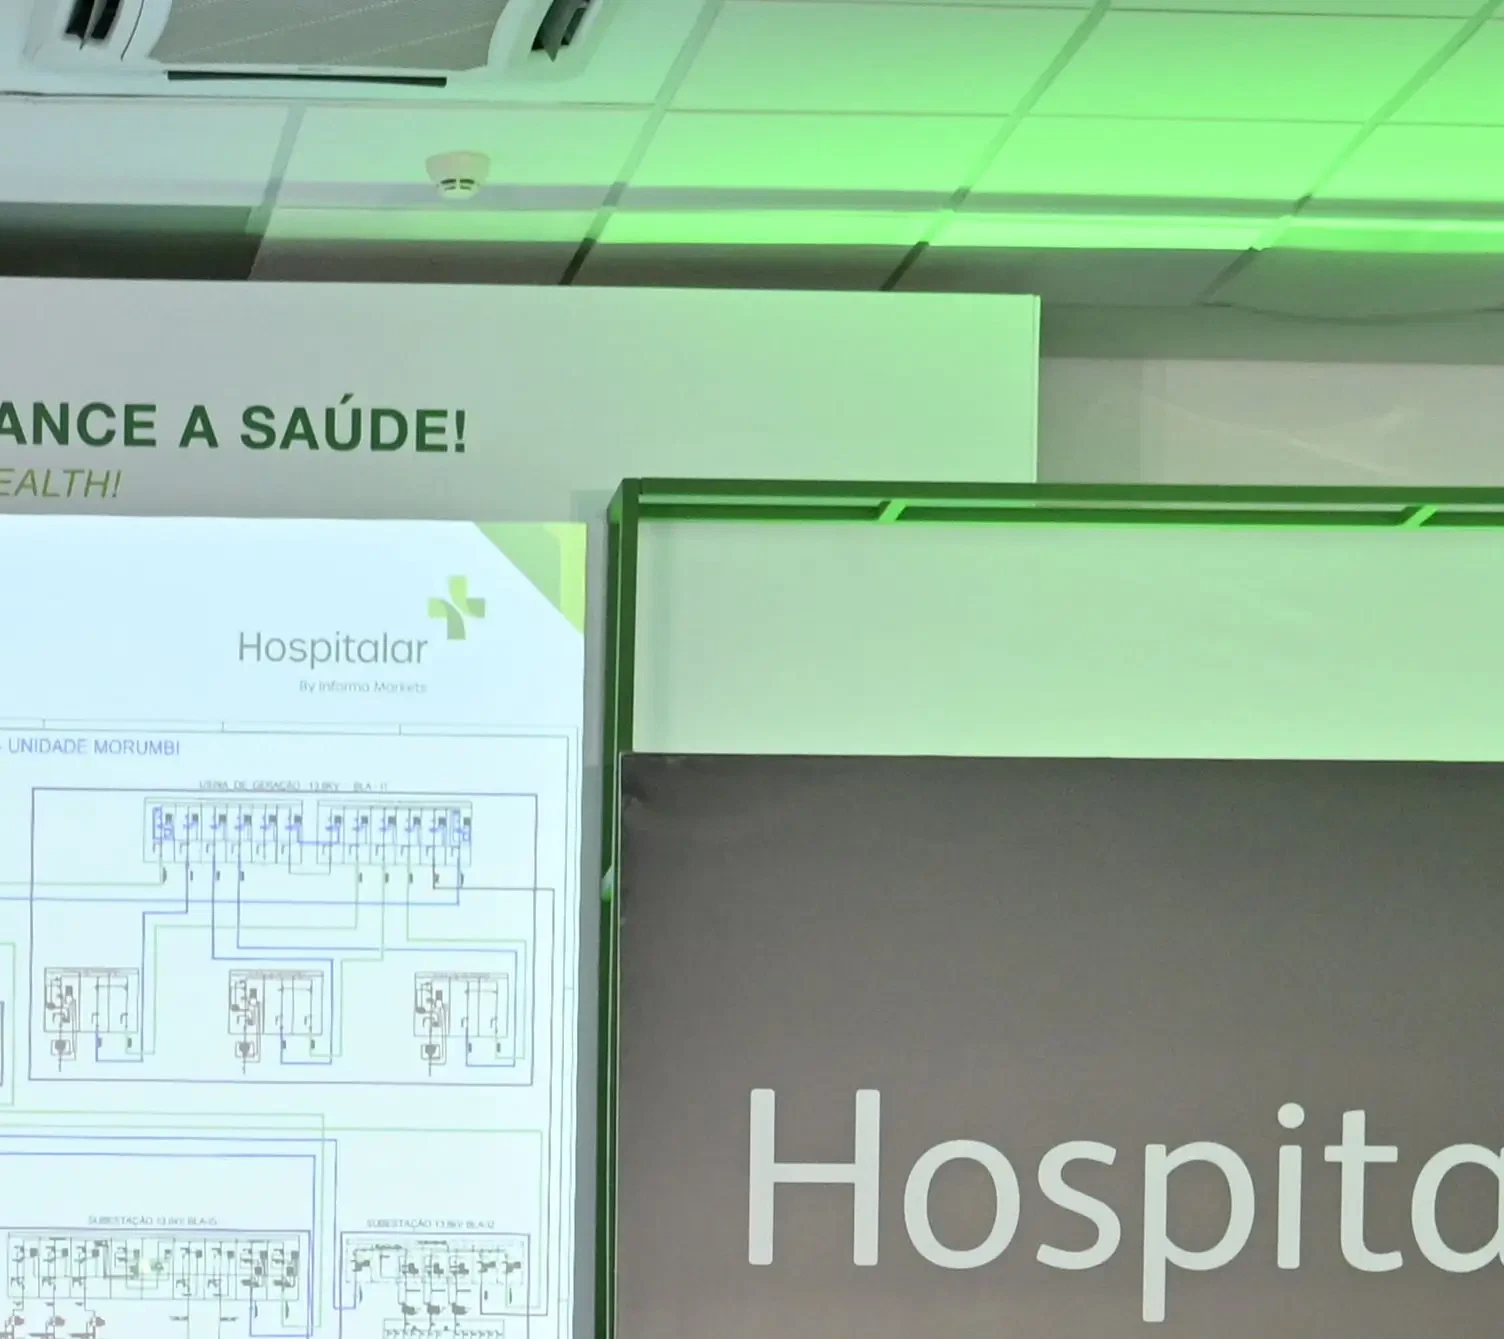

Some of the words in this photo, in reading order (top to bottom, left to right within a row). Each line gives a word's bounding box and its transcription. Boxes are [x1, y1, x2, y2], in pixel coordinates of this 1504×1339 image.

[178, 403, 220, 450] A
[240, 393, 467, 454] SAÚDE!
[238, 630, 429, 671] Hospitalar
[8, 737, 88, 755] UNIDADE
[93, 739, 180, 757] MORUMBI
